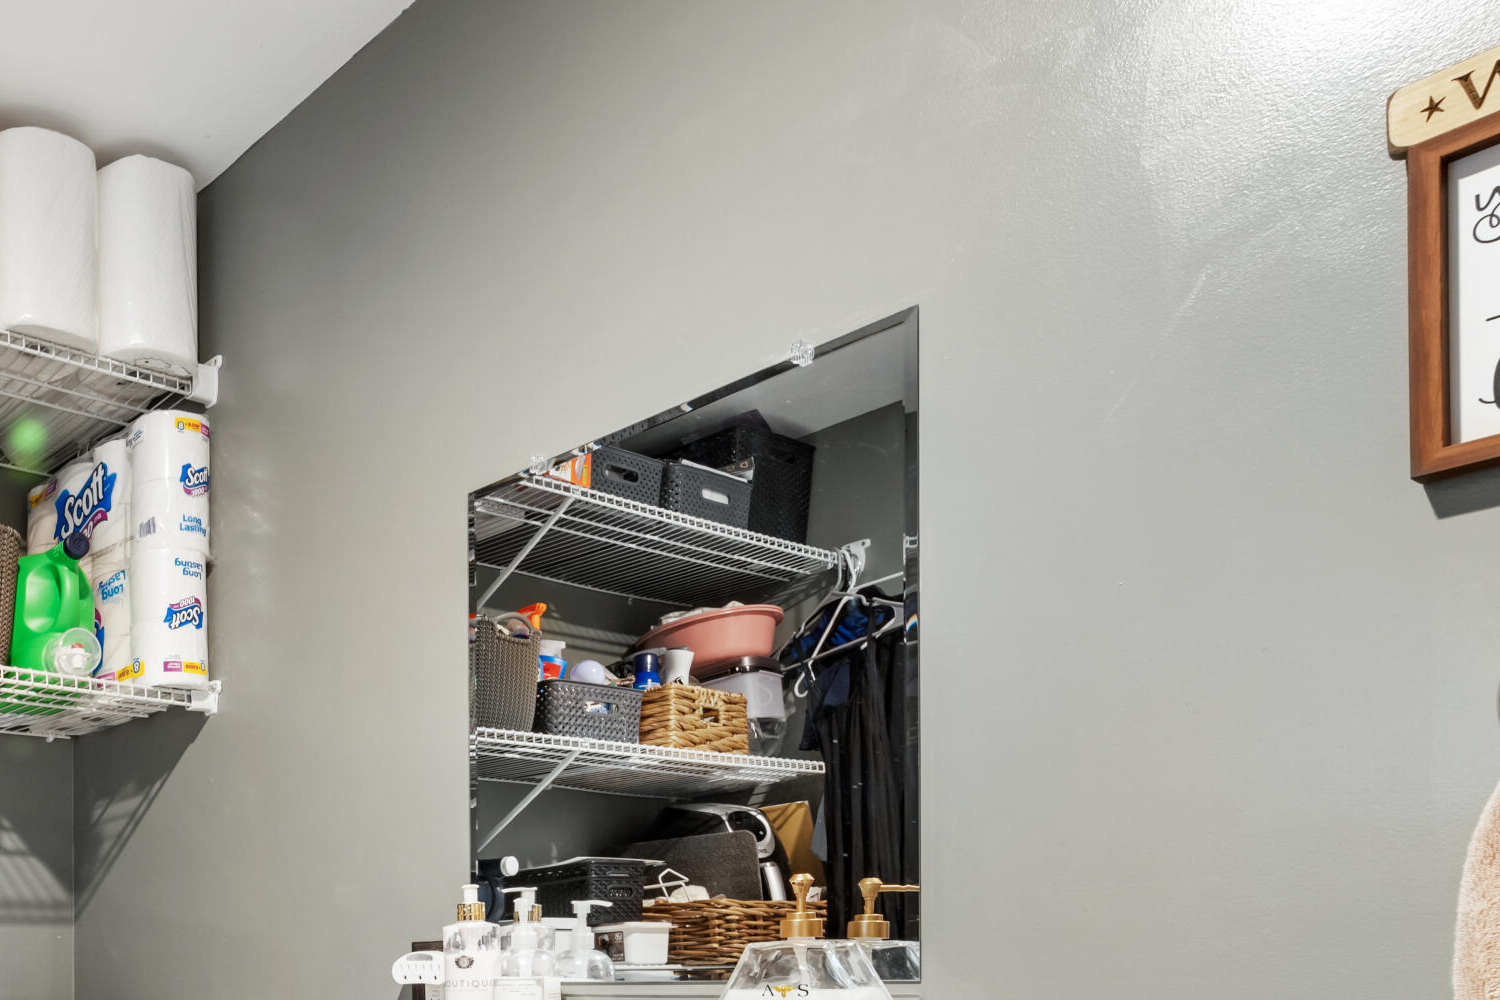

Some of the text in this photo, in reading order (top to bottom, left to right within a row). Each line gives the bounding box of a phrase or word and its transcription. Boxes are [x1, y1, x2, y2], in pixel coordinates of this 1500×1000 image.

[186, 466, 209, 488] Scott
[60, 461, 106, 539] Scott
[182, 514, 202, 526] Long
[180, 522, 207, 537] Lasting
[174, 557, 203, 572] Lasting
[182, 567, 202, 580] Long
[102, 584, 124, 601] Long
[170, 606, 201, 630] Scott
